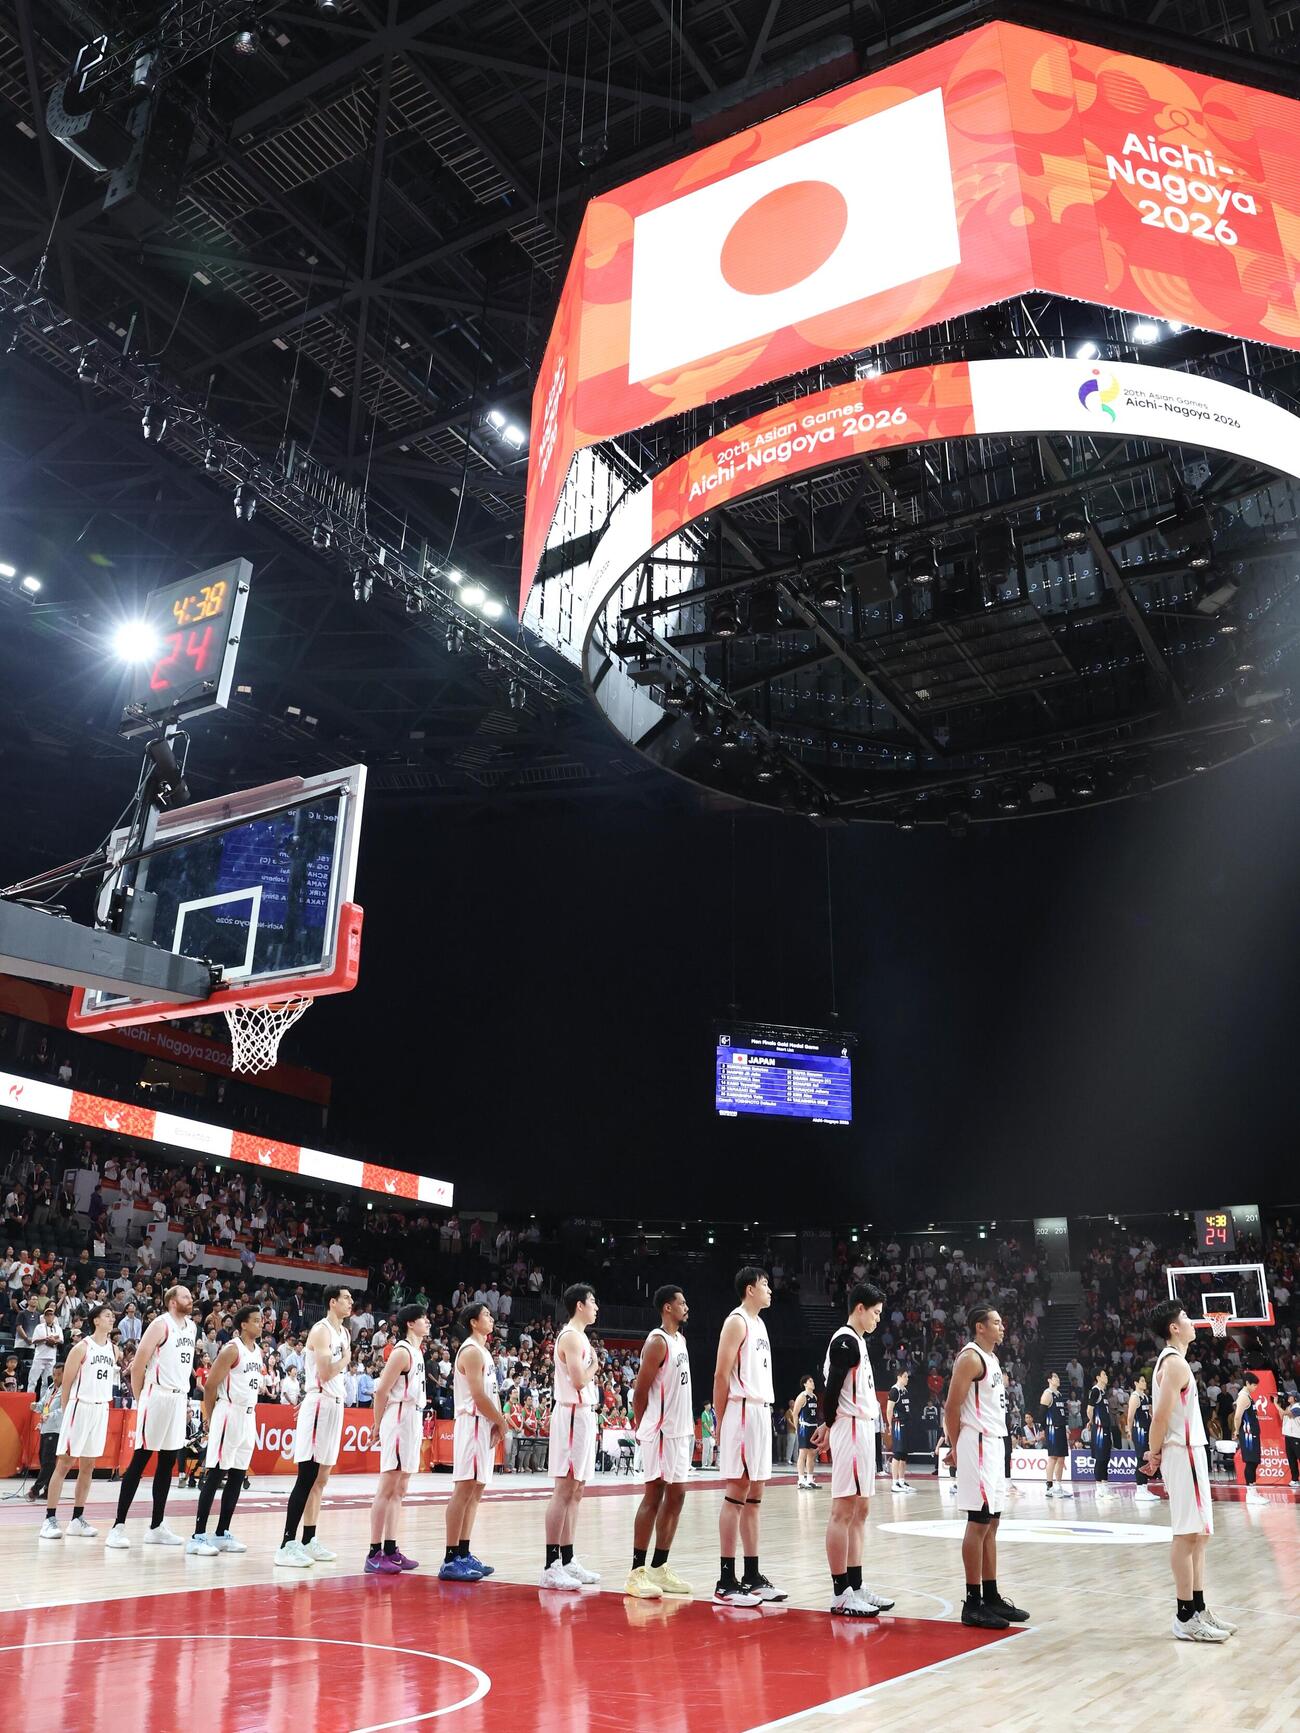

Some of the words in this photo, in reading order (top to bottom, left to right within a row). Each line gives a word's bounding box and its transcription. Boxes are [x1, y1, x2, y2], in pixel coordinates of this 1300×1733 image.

[1122, 133, 1234, 177] Aichi-
[1106, 155, 1257, 215] Nagoya
[1138, 200, 1238, 245] 2026
[1123, 388, 1146, 397] 20th
[1149, 392, 1174, 402] Asian
[1177, 397, 1209, 410] Games
[1126, 398, 1211, 420] Aichi-Nagoya
[1213, 413, 1241, 429] 2026
[717, 441, 750, 465] 20th
[753, 422, 797, 448] Asian
[801, 402, 865, 428] Games
[688, 425, 836, 502] Aichi-Nagoya
[842, 407, 908, 438] 2026
[150, 626, 213, 691] 24
[748, 1056, 776, 1066] JAPAN
[1206, 1215, 1227, 1227] 4:38
[1245, 1214, 1258, 1222] 201
[1206, 1228, 1226, 1245] 24
[175, 1337, 195, 1348] JAPAN
[90, 1354, 114, 1367] JAPAN
[180, 1352, 191, 1364] 53
[96, 1369, 108, 1380] 64
[248, 1378, 258, 1390] 45
[343, 1425, 381, 1452] 20
[1260, 1446, 1284, 1456] ichi-
[1260, 1458, 1290, 1467] agoya
[1259, 1468, 1285, 1477] 2026
